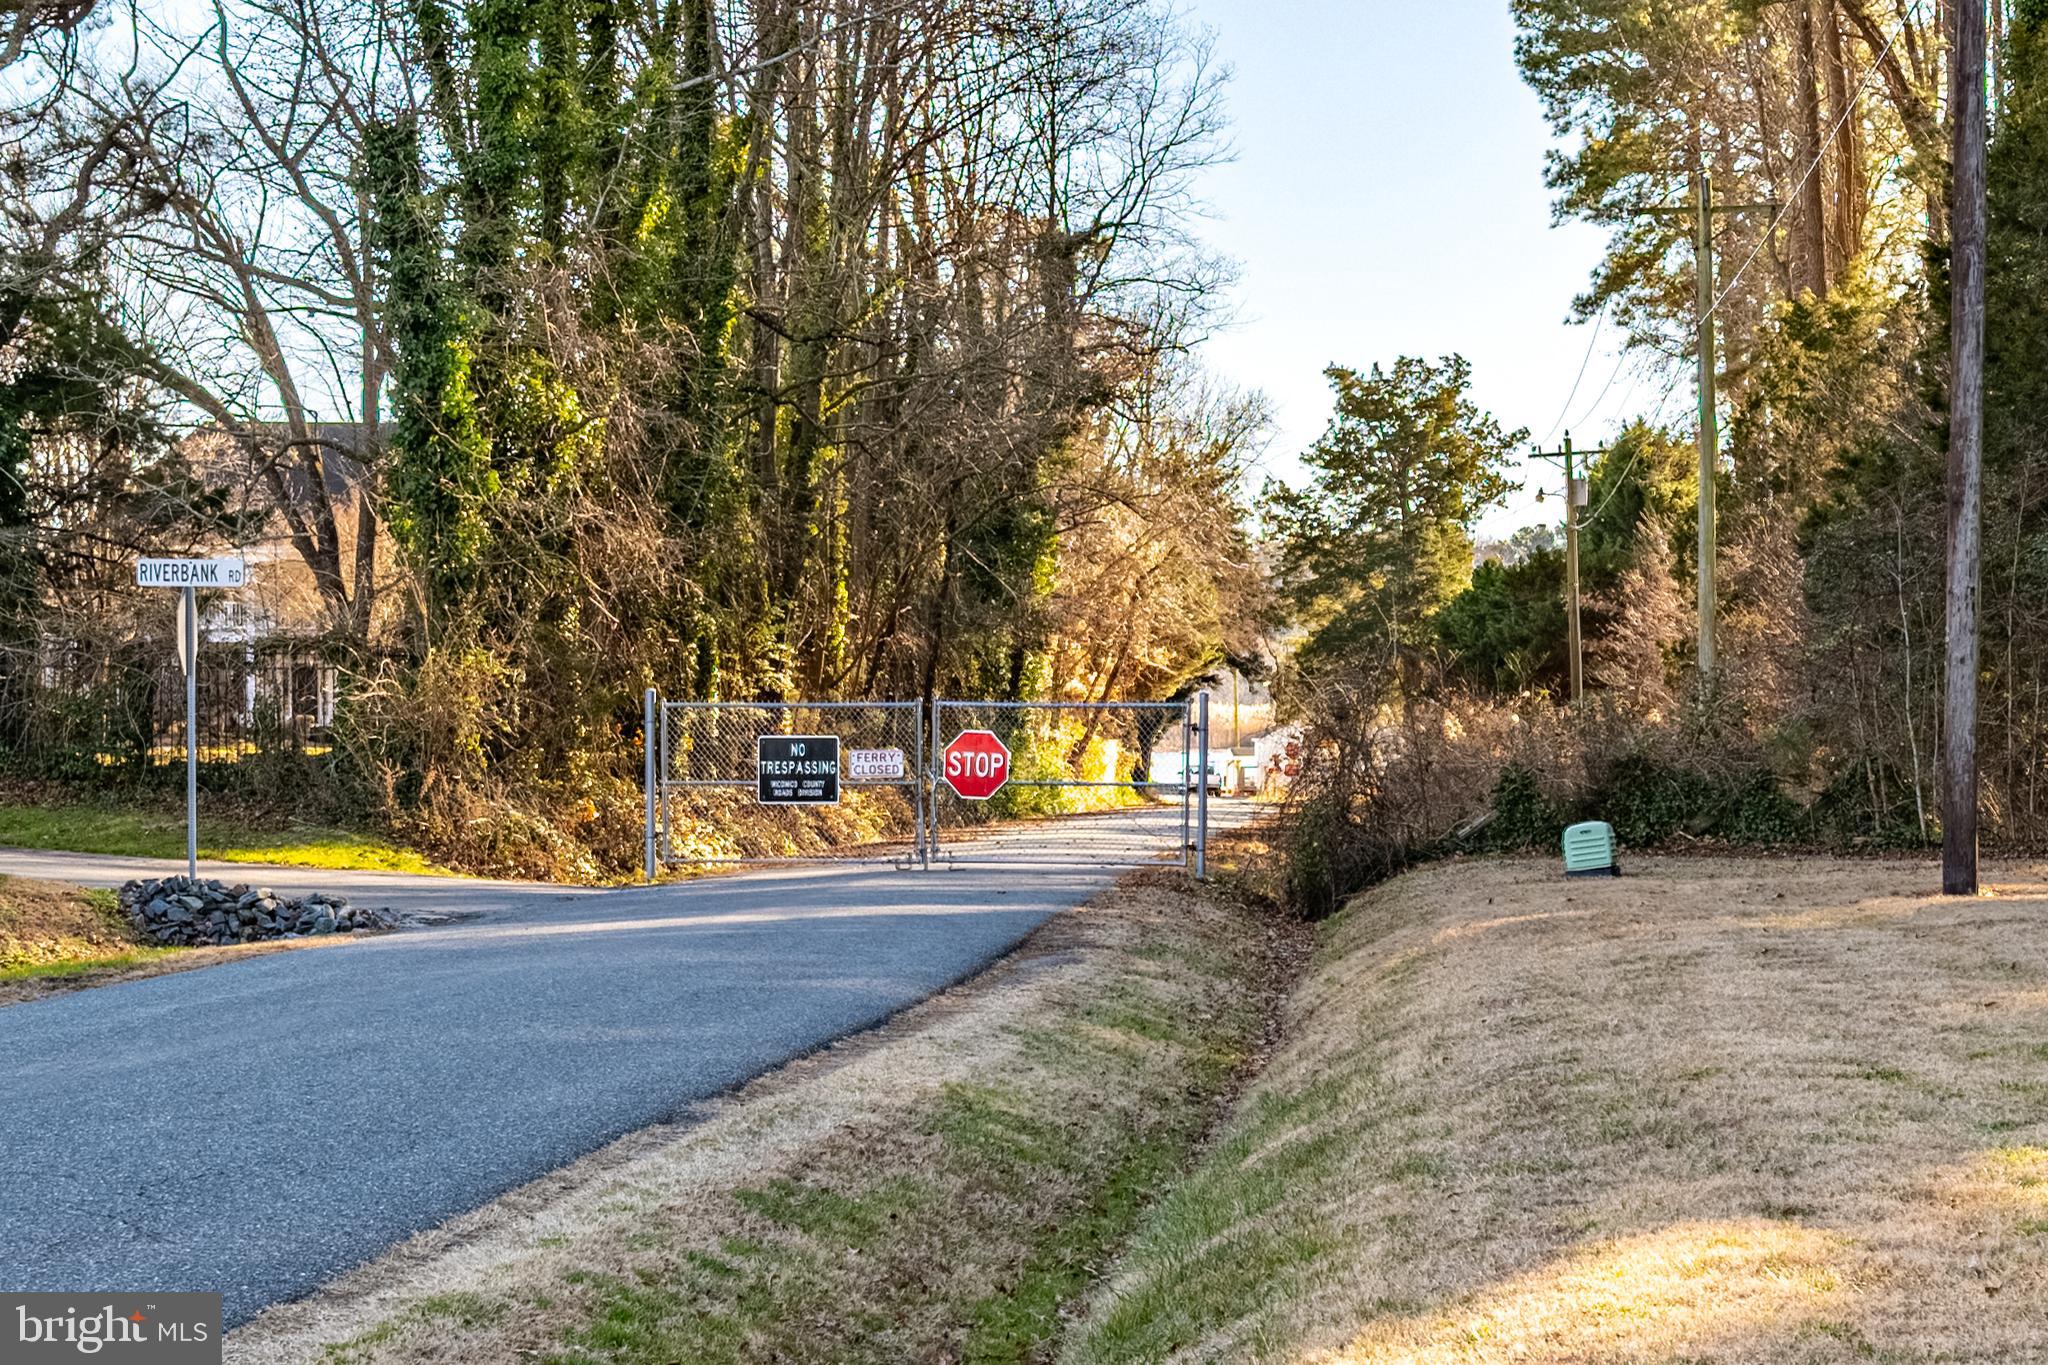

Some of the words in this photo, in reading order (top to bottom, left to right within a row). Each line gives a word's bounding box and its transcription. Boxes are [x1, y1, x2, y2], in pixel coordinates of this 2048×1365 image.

[140, 564, 218, 582] RIVERBANK
[229, 570, 242, 582] RD
[790, 743, 806, 757] NO
[856, 753, 895, 762] FERRY
[948, 751, 1004, 778] STOP
[761, 760, 836, 774] TRESPASSING
[853, 765, 900, 775] CLOSED
[802, 780, 825, 788] COUNTY
